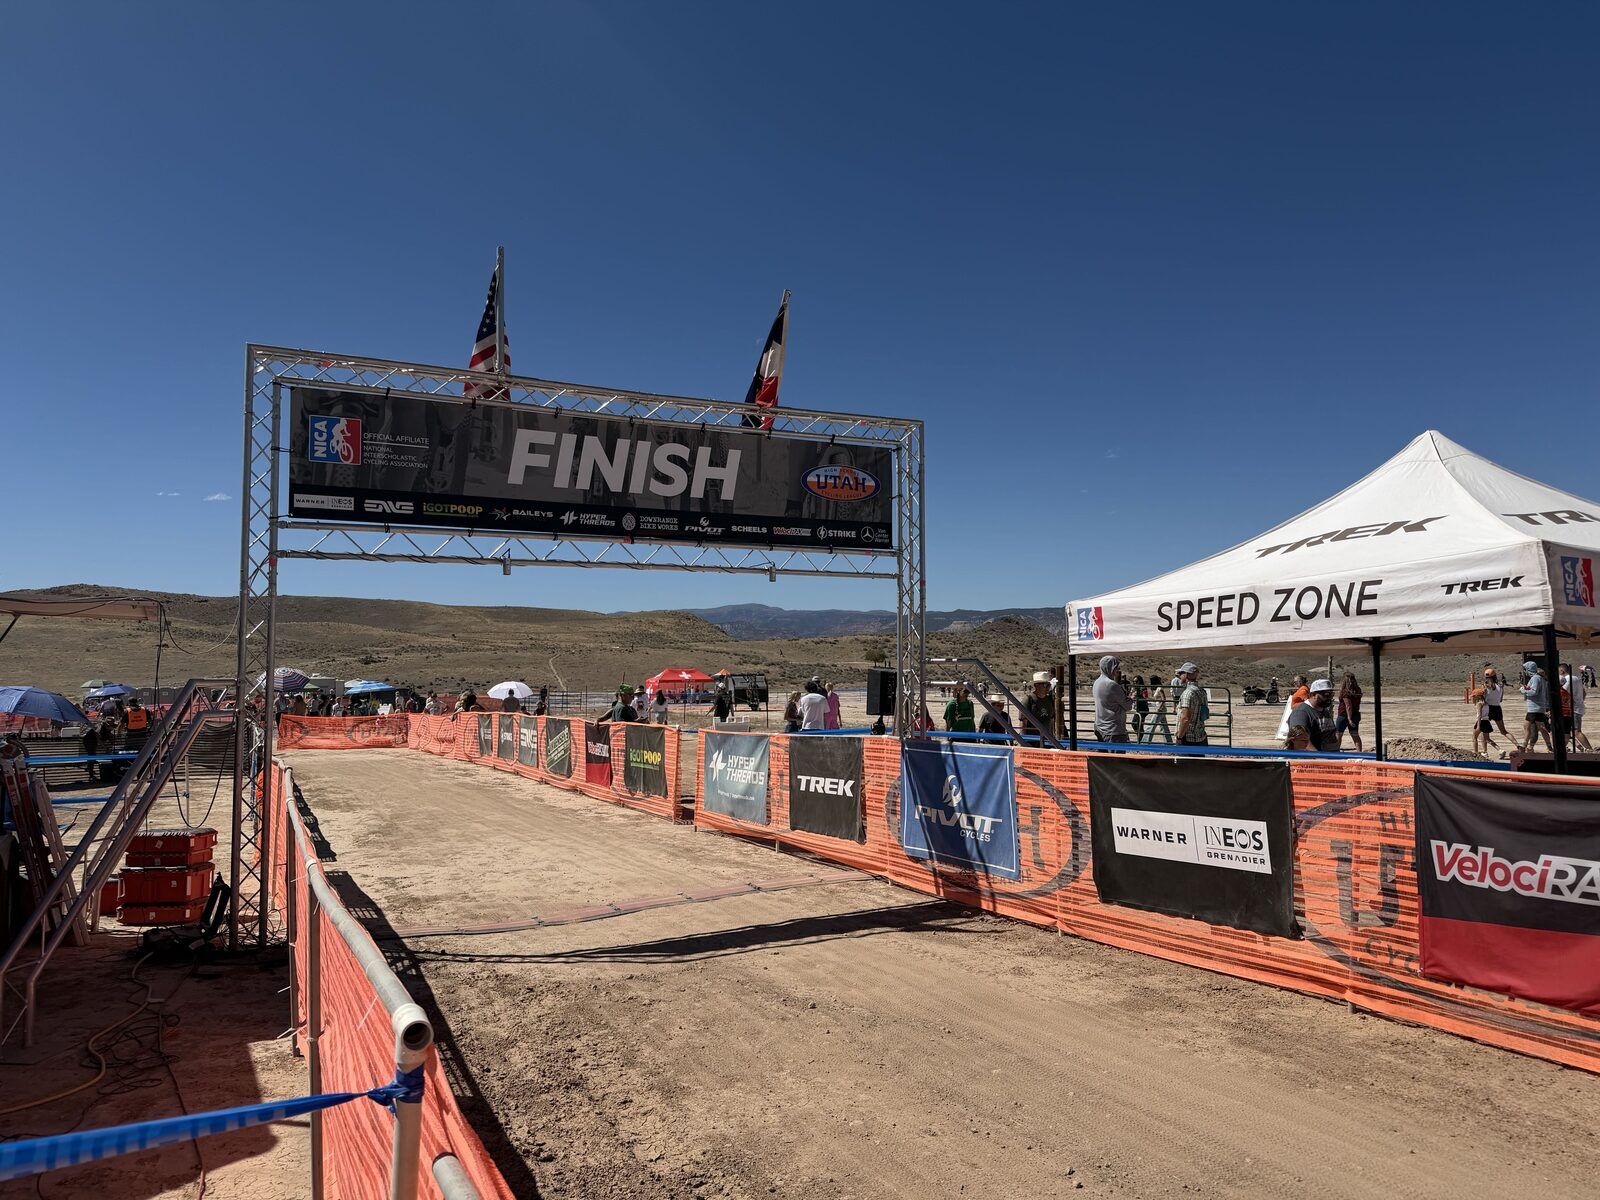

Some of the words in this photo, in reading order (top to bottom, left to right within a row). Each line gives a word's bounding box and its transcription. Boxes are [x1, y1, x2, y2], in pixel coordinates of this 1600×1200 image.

[314, 420, 327, 458] NICA
[363, 432, 393, 442] OFFICIAL
[396, 435, 430, 445] AFFILIATE
[363, 452, 417, 462] INTERSCHOLASTIC
[390, 461, 428, 469] ASSOCIATION
[507, 428, 741, 501] FINISH
[816, 474, 866, 493] UTAH
[512, 509, 554, 518] BAILEYS
[1501, 510, 1600, 526] TR
[580, 519, 616, 527] THREADS
[828, 530, 856, 538] STRIKE
[1256, 515, 1450, 559] TREK
[1440, 576, 1526, 596] TREK
[1563, 561, 1576, 600] NICA
[1157, 592, 1260, 632] SPEED
[1270, 579, 1383, 623] ZONE
[1078, 610, 1087, 638] NICA
[727, 754, 756, 770] HYPER
[726, 768, 764, 786] THREADS
[797, 775, 855, 798] TREK
[914, 804, 1002, 833] PIVOT
[960, 830, 991, 842] CYCLES
[1116, 825, 1188, 845] WARNER
[1204, 825, 1264, 851] INEOS
[1206, 851, 1266, 866] GRENADIER
